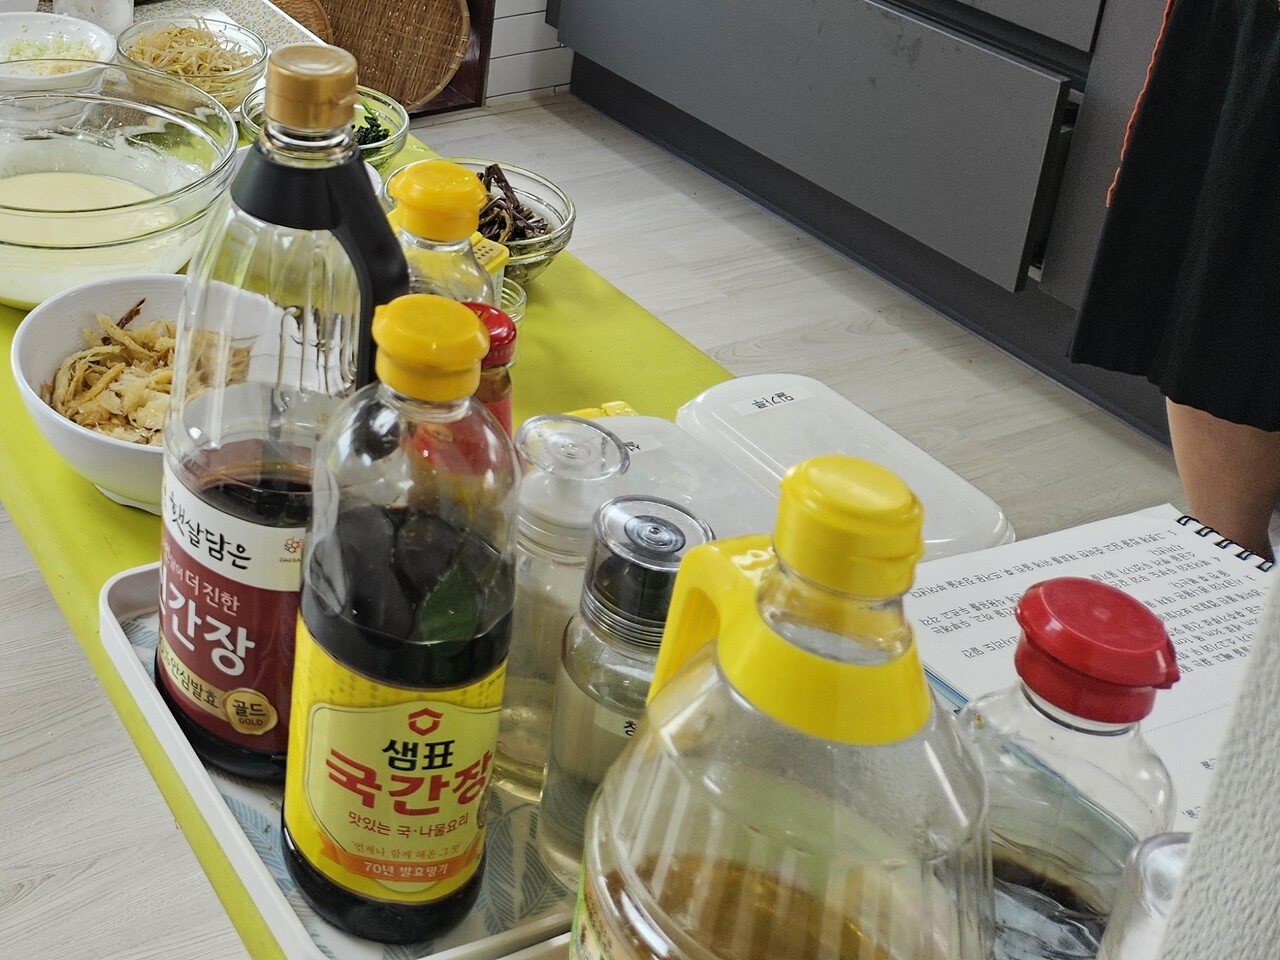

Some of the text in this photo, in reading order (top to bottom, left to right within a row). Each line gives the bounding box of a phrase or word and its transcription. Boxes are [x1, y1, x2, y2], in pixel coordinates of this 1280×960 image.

[751, 391, 795, 409] 밀가루
[169, 490, 252, 571] 햇살담은
[945, 577, 976, 588] 장국을
[973, 572, 1002, 583] 뜨거운
[185, 569, 241, 617] 더 진한
[918, 616, 942, 626] 각각
[939, 606, 971, 619] 두르고
[232, 698, 268, 718] 골드
[238, 717, 264, 727] GOLD
[382, 739, 456, 772] 샘표
[325, 749, 493, 816] 국간장
[348, 811, 392, 836] 맛있는
[364, 861, 394, 877] 70년
